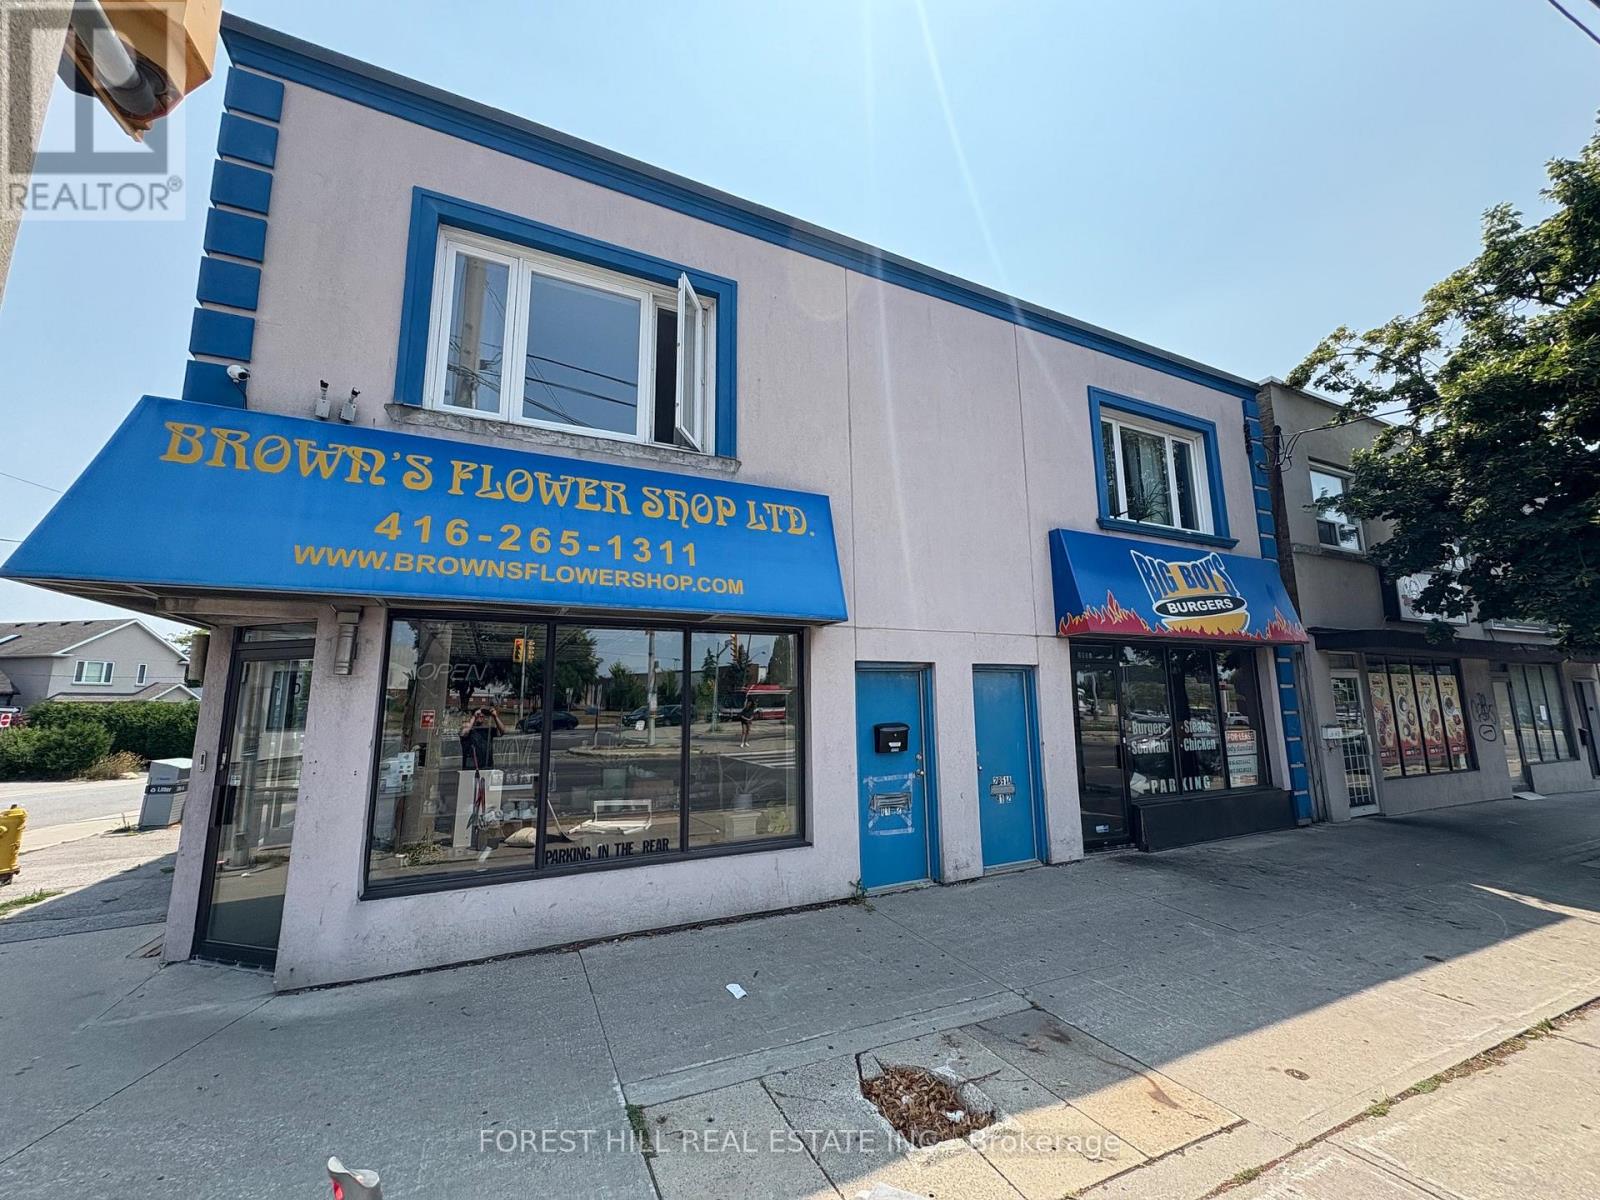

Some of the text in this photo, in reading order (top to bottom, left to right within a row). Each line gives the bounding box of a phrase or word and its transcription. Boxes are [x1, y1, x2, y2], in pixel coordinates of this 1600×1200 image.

[160, 421, 816, 538] BROWN'S FLOWER SHOP LTD.
[374, 511, 697, 567] 416-265-1311
[293, 544, 744, 595] WWW.BROWNSFLOWERSHOP.COM
[1131, 550, 1179, 602] BIG
[1166, 598, 1234, 614] BURGERS
[416, 662, 489, 682] OPEN
[1131, 719, 1212, 736] Burgers Steaks
[1184, 737, 1216, 752] Chicken
[1150, 775, 1211, 795] PARKING
[545, 838, 670, 865] PARKING IN THE REAR
